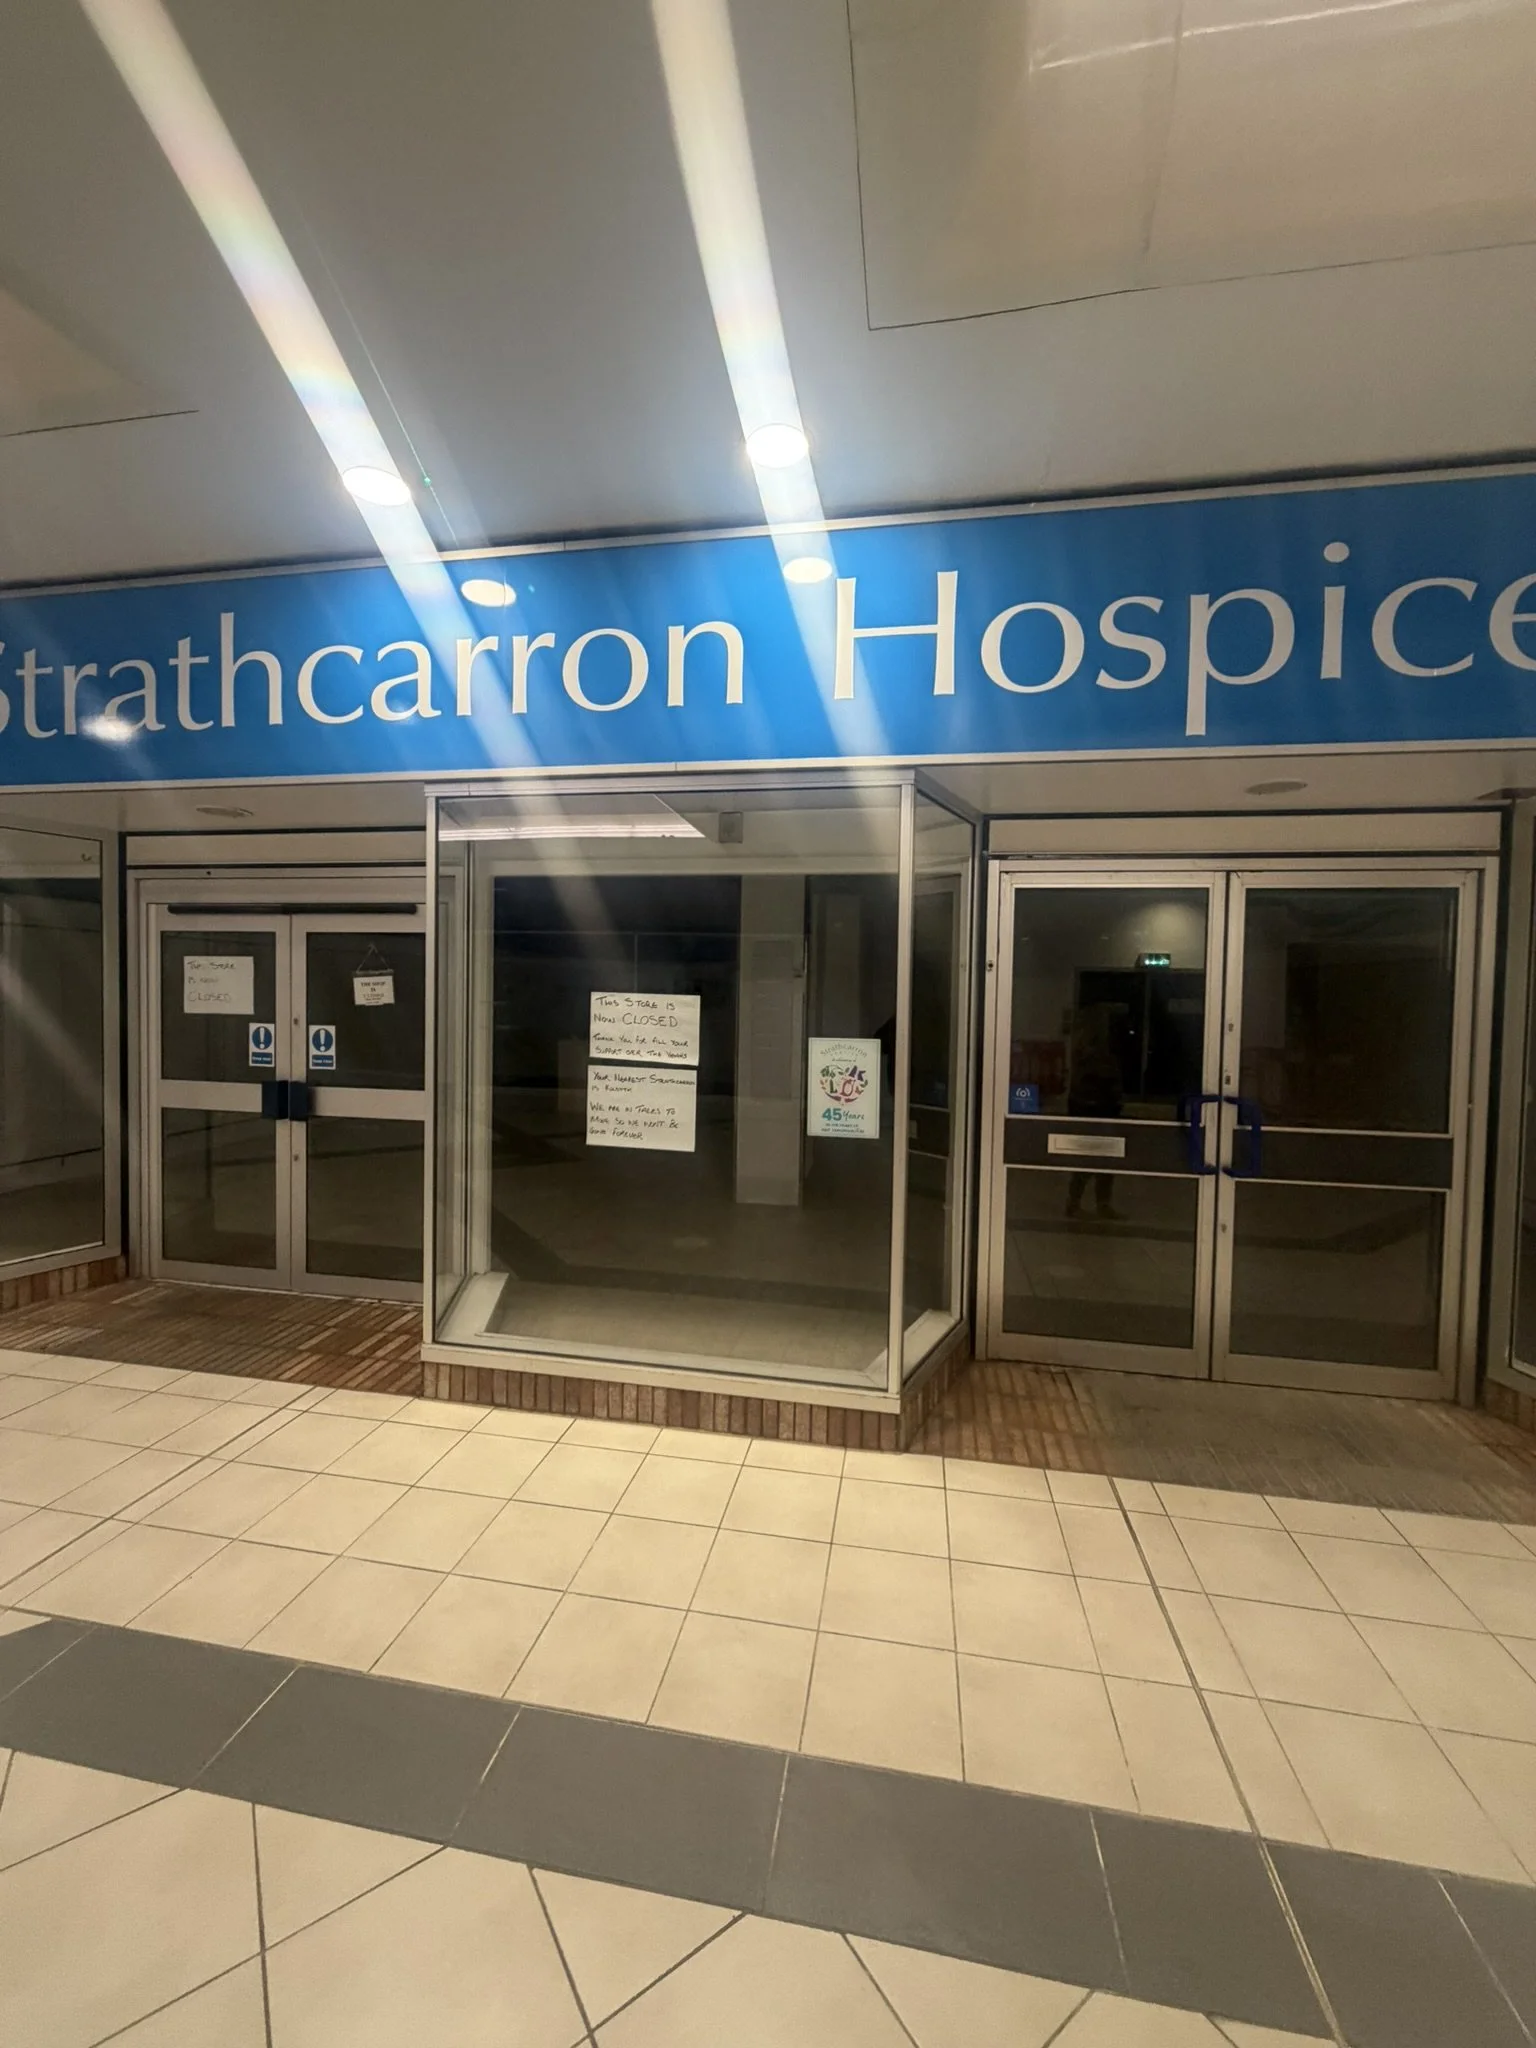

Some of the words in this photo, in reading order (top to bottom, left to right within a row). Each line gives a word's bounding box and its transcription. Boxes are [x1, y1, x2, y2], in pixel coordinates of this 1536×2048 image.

[0, 612, 744, 738] trathcarron
[622, 1012, 678, 1028] CLOSED
[822, 1108, 842, 1121] 45
